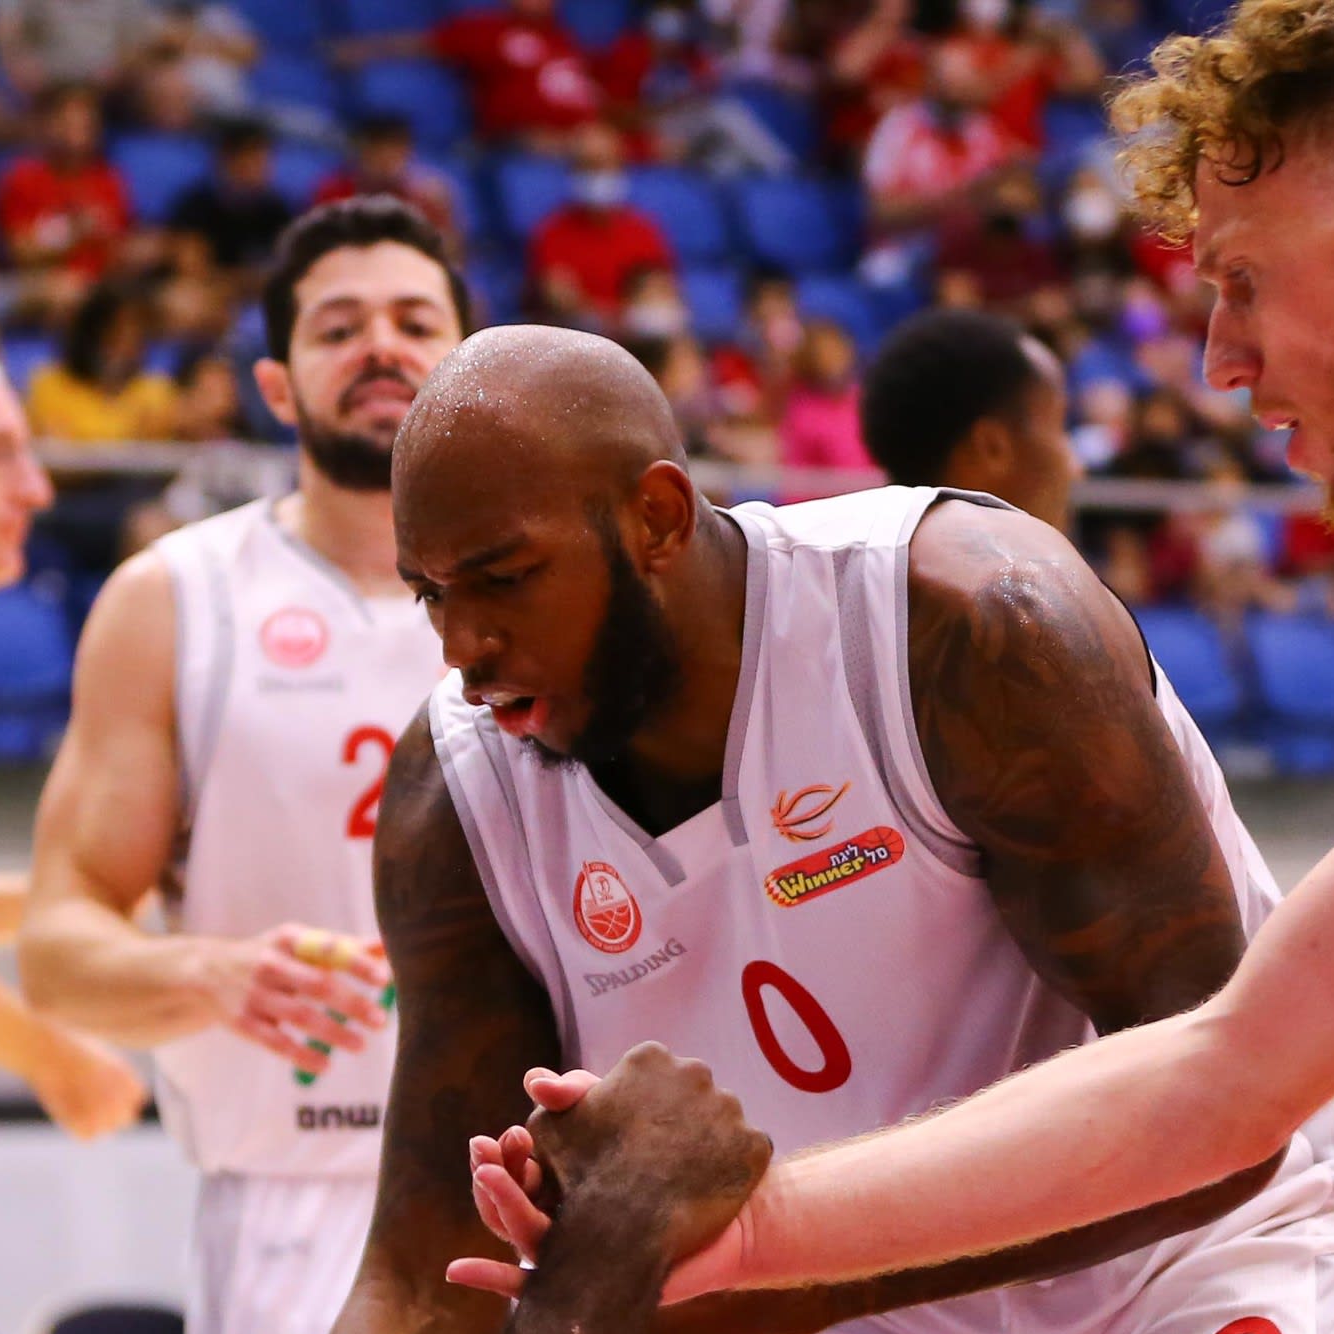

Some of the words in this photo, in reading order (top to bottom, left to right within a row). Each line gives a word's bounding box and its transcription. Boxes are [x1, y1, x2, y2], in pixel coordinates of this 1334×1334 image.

[779, 855, 865, 899] Winner
[864, 846, 888, 864] סל
[583, 937, 688, 997] SPALDING
[741, 960, 852, 1093] 0
